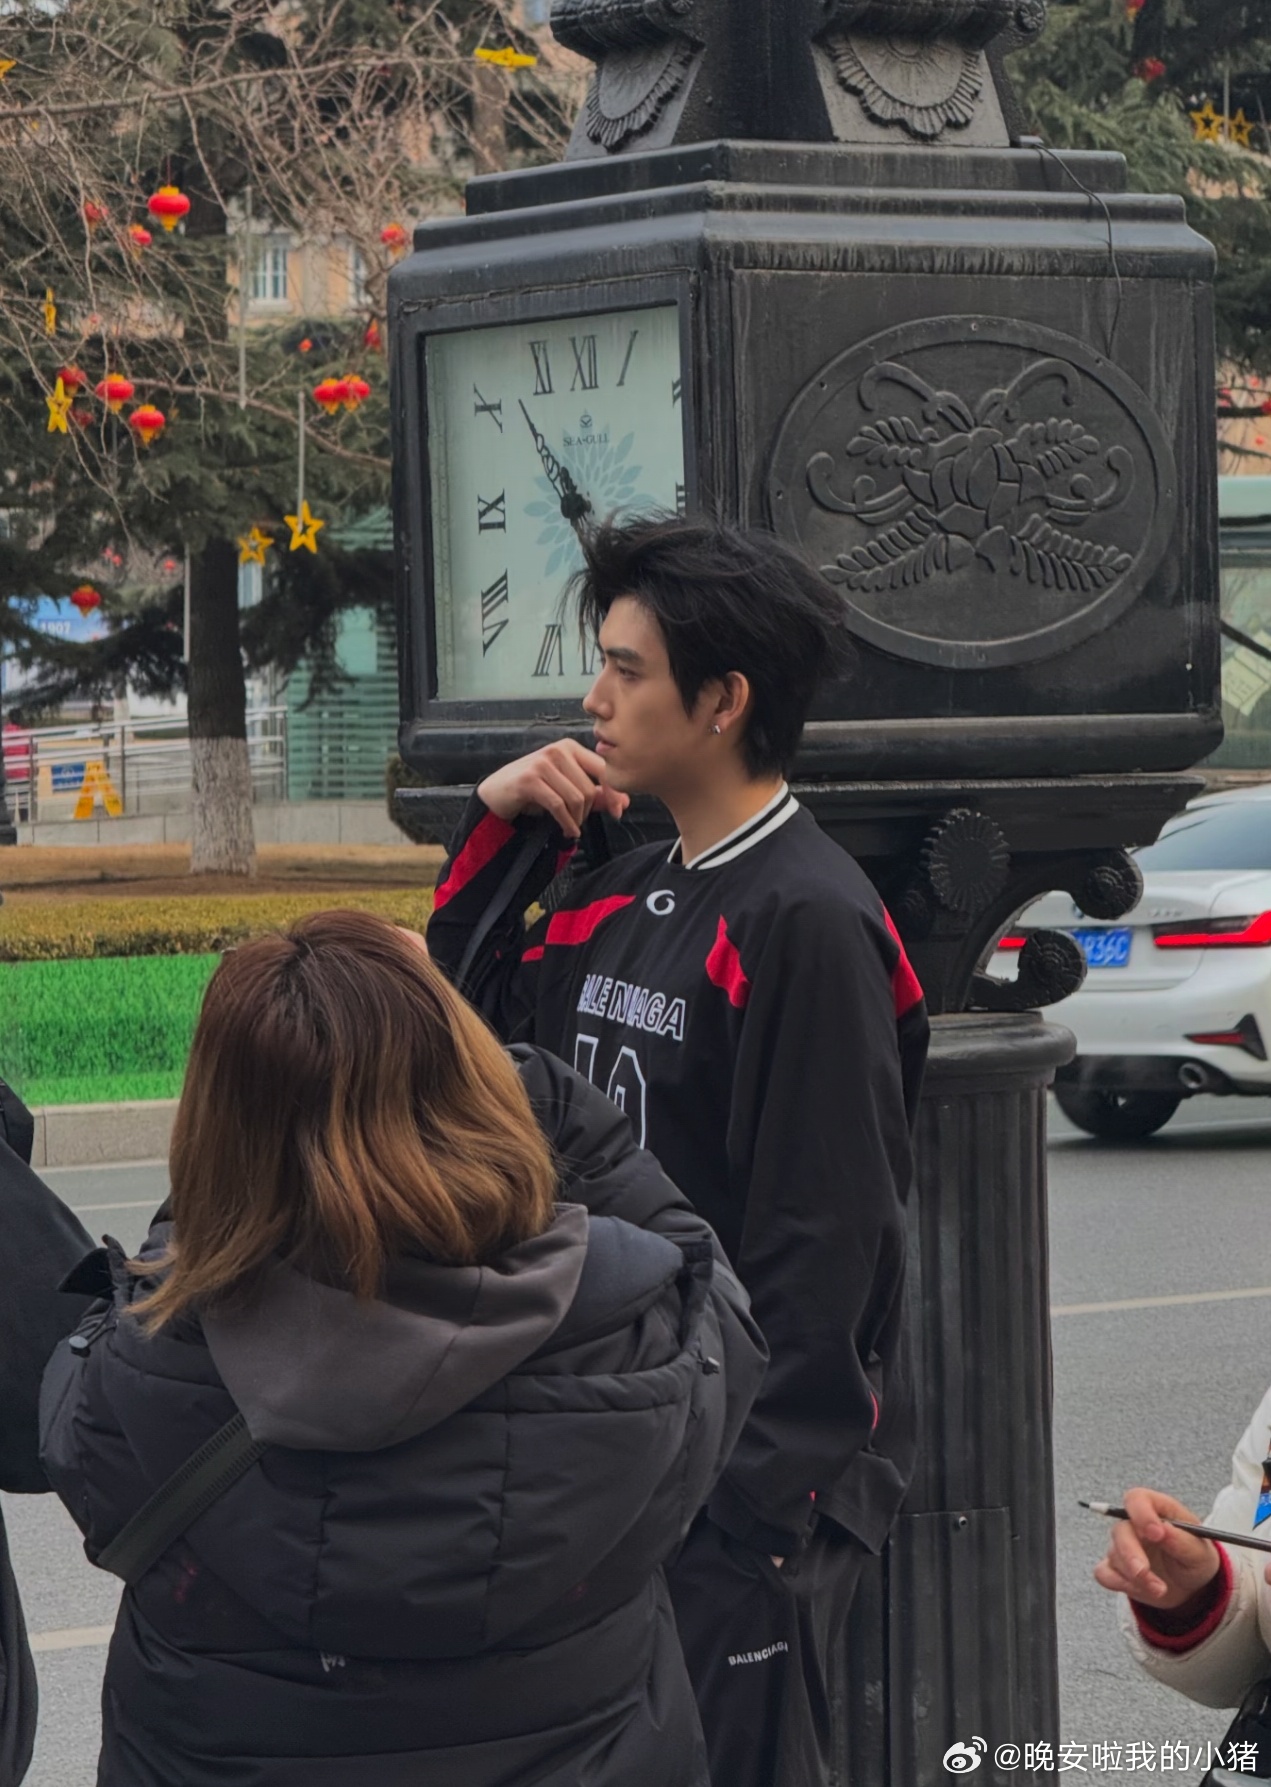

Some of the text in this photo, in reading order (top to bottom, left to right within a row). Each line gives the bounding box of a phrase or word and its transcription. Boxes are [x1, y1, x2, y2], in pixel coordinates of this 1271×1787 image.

[528, 340, 555, 396] XI
[568, 334, 599, 392] XII
[477, 488, 507, 535] IX
